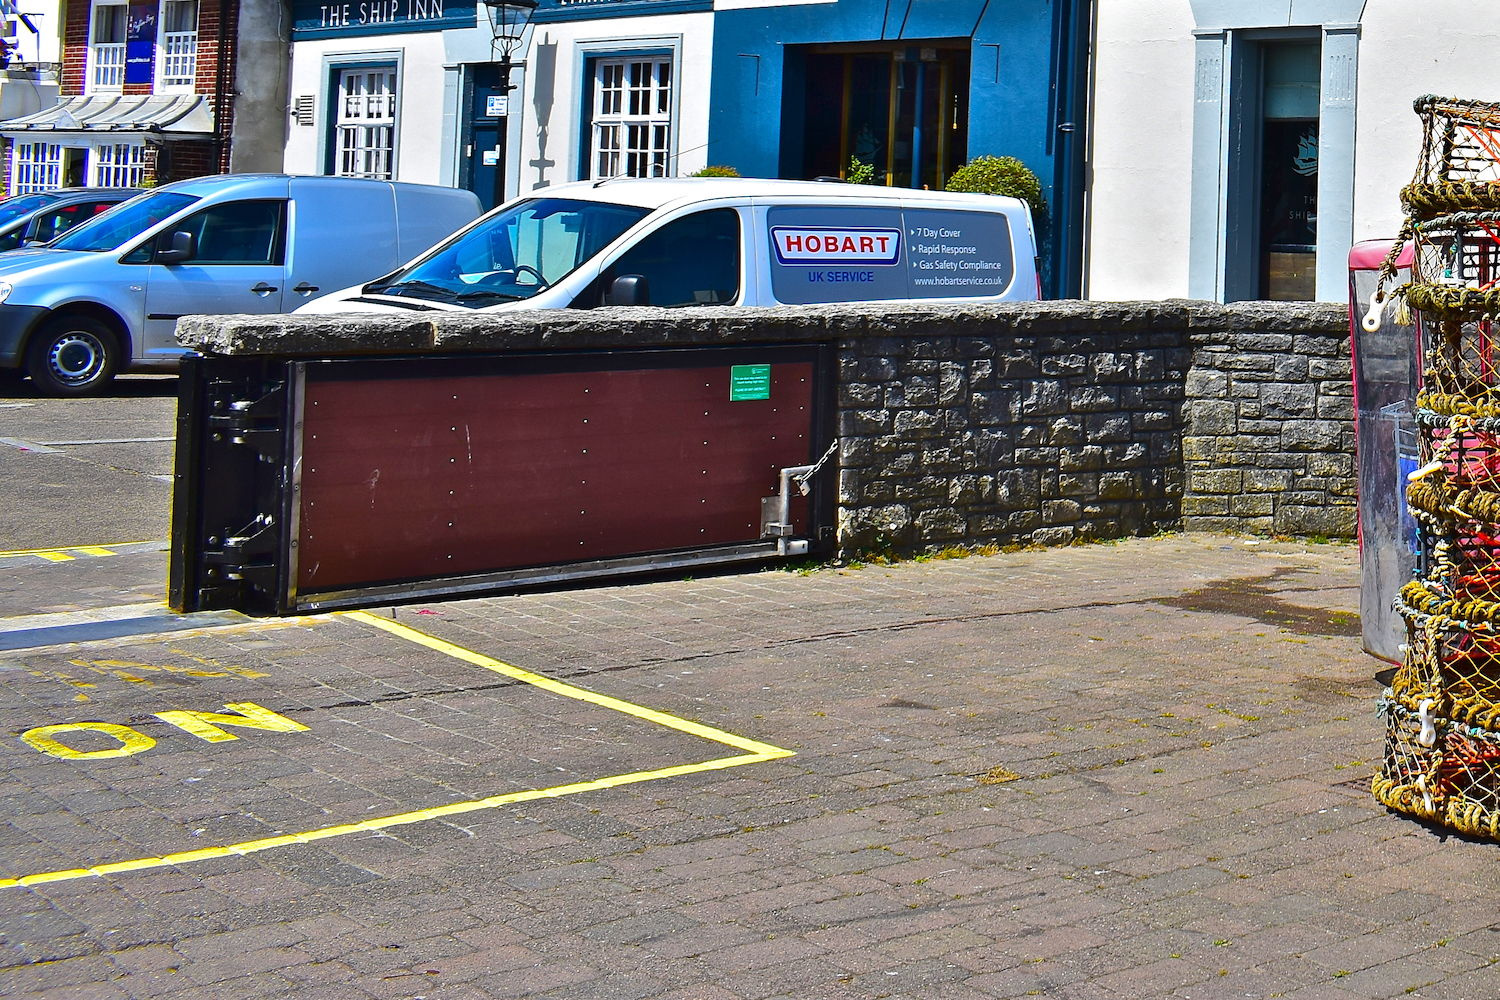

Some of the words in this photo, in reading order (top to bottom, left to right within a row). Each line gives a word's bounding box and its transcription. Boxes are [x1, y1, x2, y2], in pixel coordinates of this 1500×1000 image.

[320, 3, 350, 28] THE
[359, 0, 399, 25] SHIP
[916, 228, 922, 237] 7
[923, 228, 938, 239] Day
[939, 228, 961, 238] Cover
[785, 235, 890, 253] HOBART
[918, 244, 940, 255] Rapid
[941, 244, 977, 255] Response
[919, 260, 934, 270] Gas
[935, 260, 958, 271] Safety
[959, 260, 1002, 271] Compliance
[808, 271, 824, 282] UK
[827, 271, 874, 282] SERVICE
[914, 276, 1003, 286] www.hobartservice.co.uk
